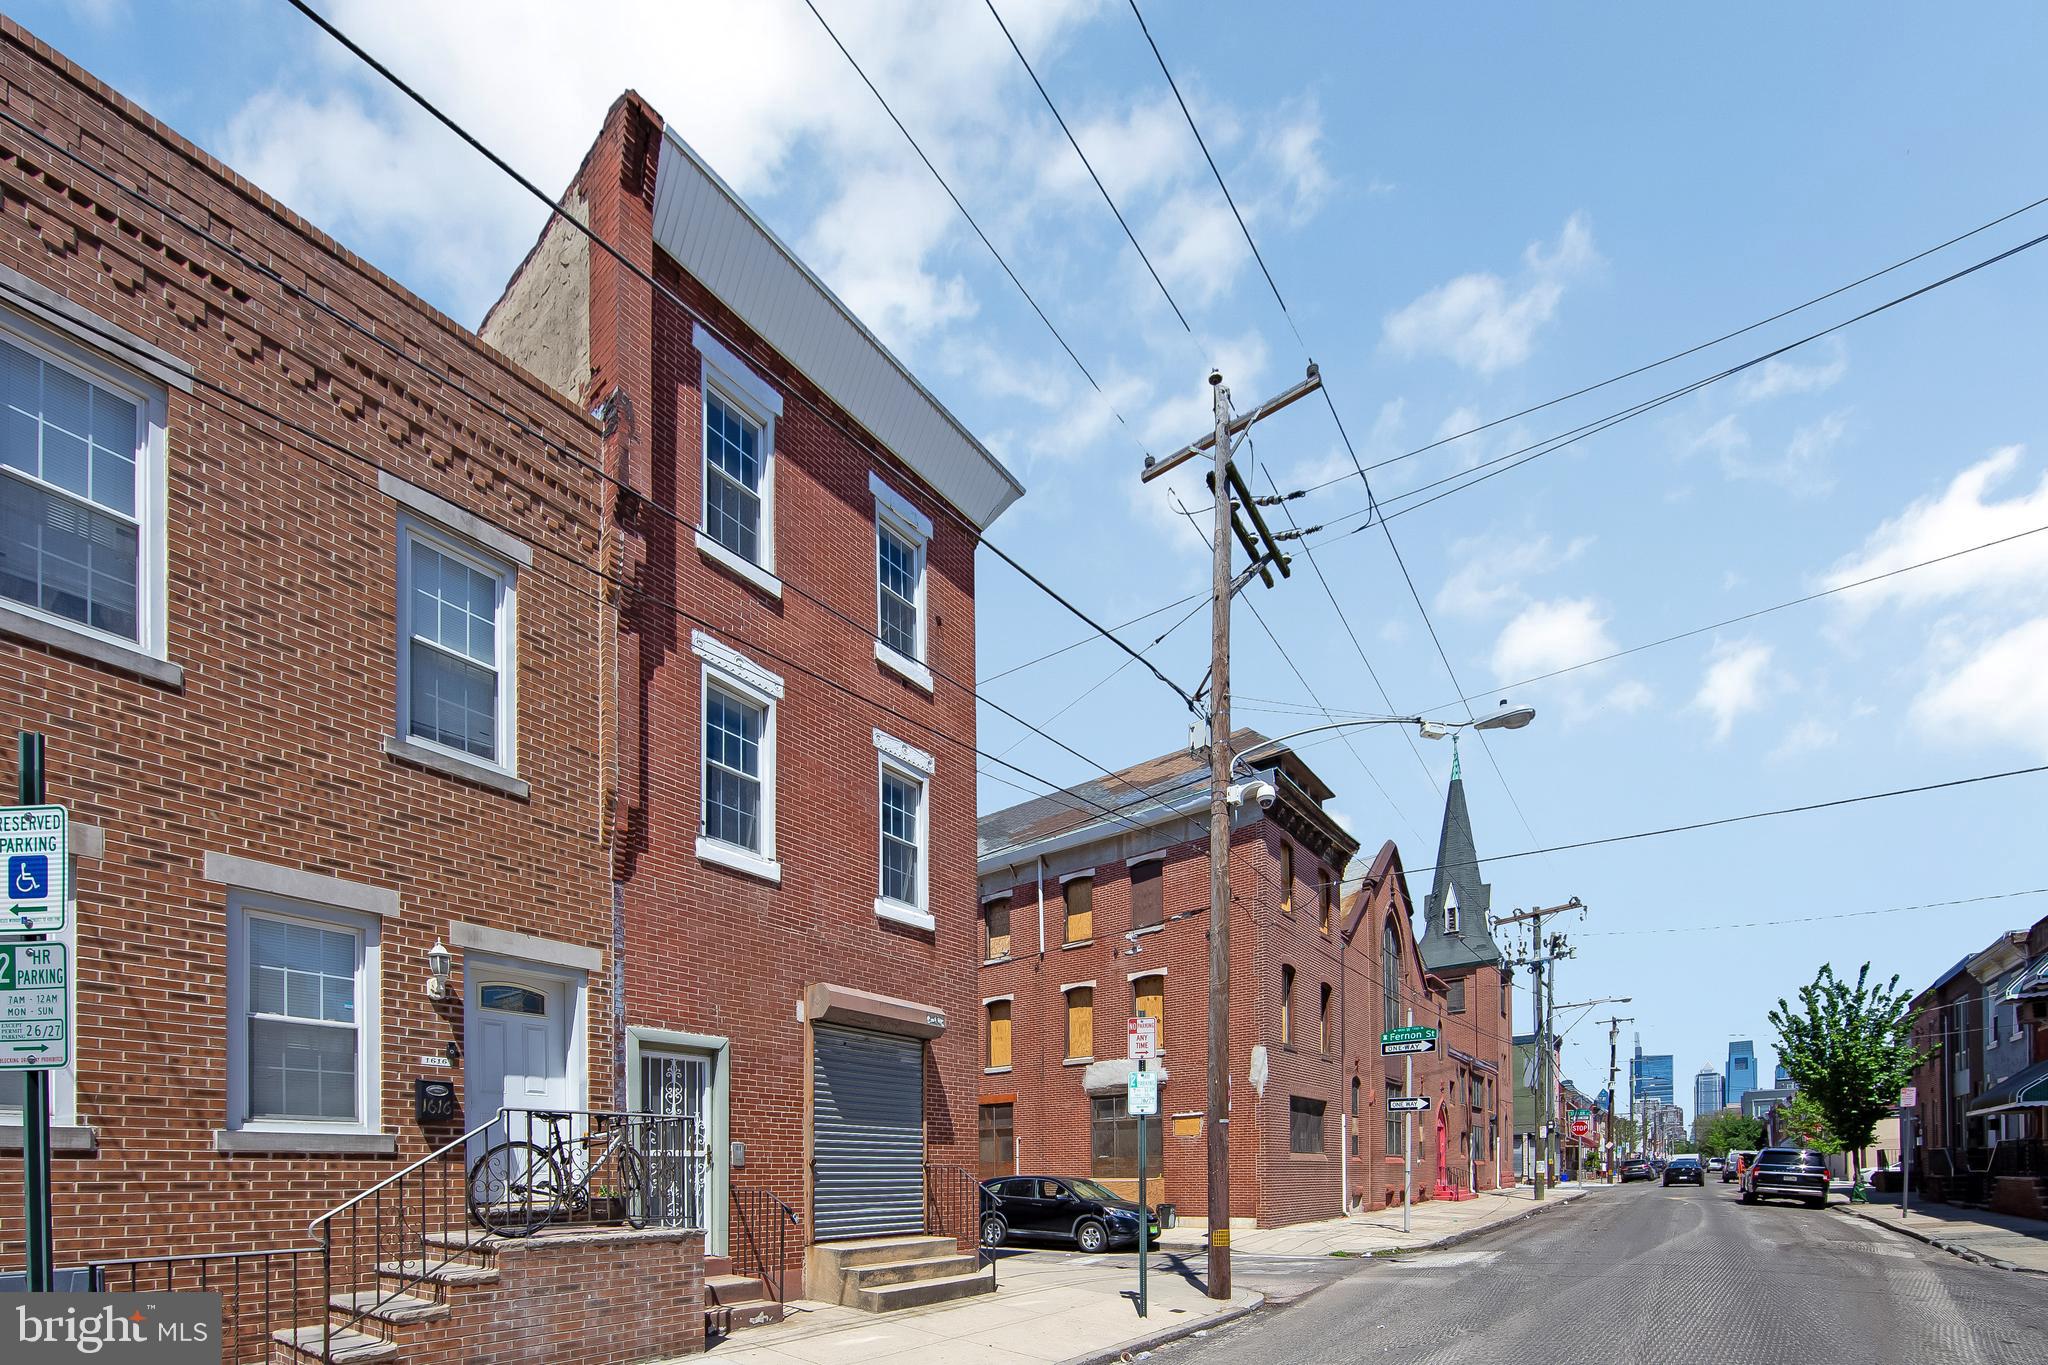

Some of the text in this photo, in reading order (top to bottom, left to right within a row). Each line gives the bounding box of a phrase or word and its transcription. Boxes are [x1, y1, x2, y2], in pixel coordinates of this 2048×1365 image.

[0, 836, 57, 853] PARKING
[32, 949, 51, 965] HR
[17, 968, 64, 985] PARKING
[8, 995, 26, 1004] 7AM
[36, 994, 58, 1003] 12AM
[7, 1007, 27, 1016] MON
[37, 1006, 54, 1015] SUN
[26, 1024, 61, 1038] 26/27
[1129, 1022, 1136, 1030] NO
[1390, 1031, 1422, 1041] Fernon
[1425, 1030, 1435, 1038] St
[1387, 1042, 1420, 1052] ONE WAY
[426, 1057, 448, 1065] 1616
[423, 1098, 452, 1115] 1616
